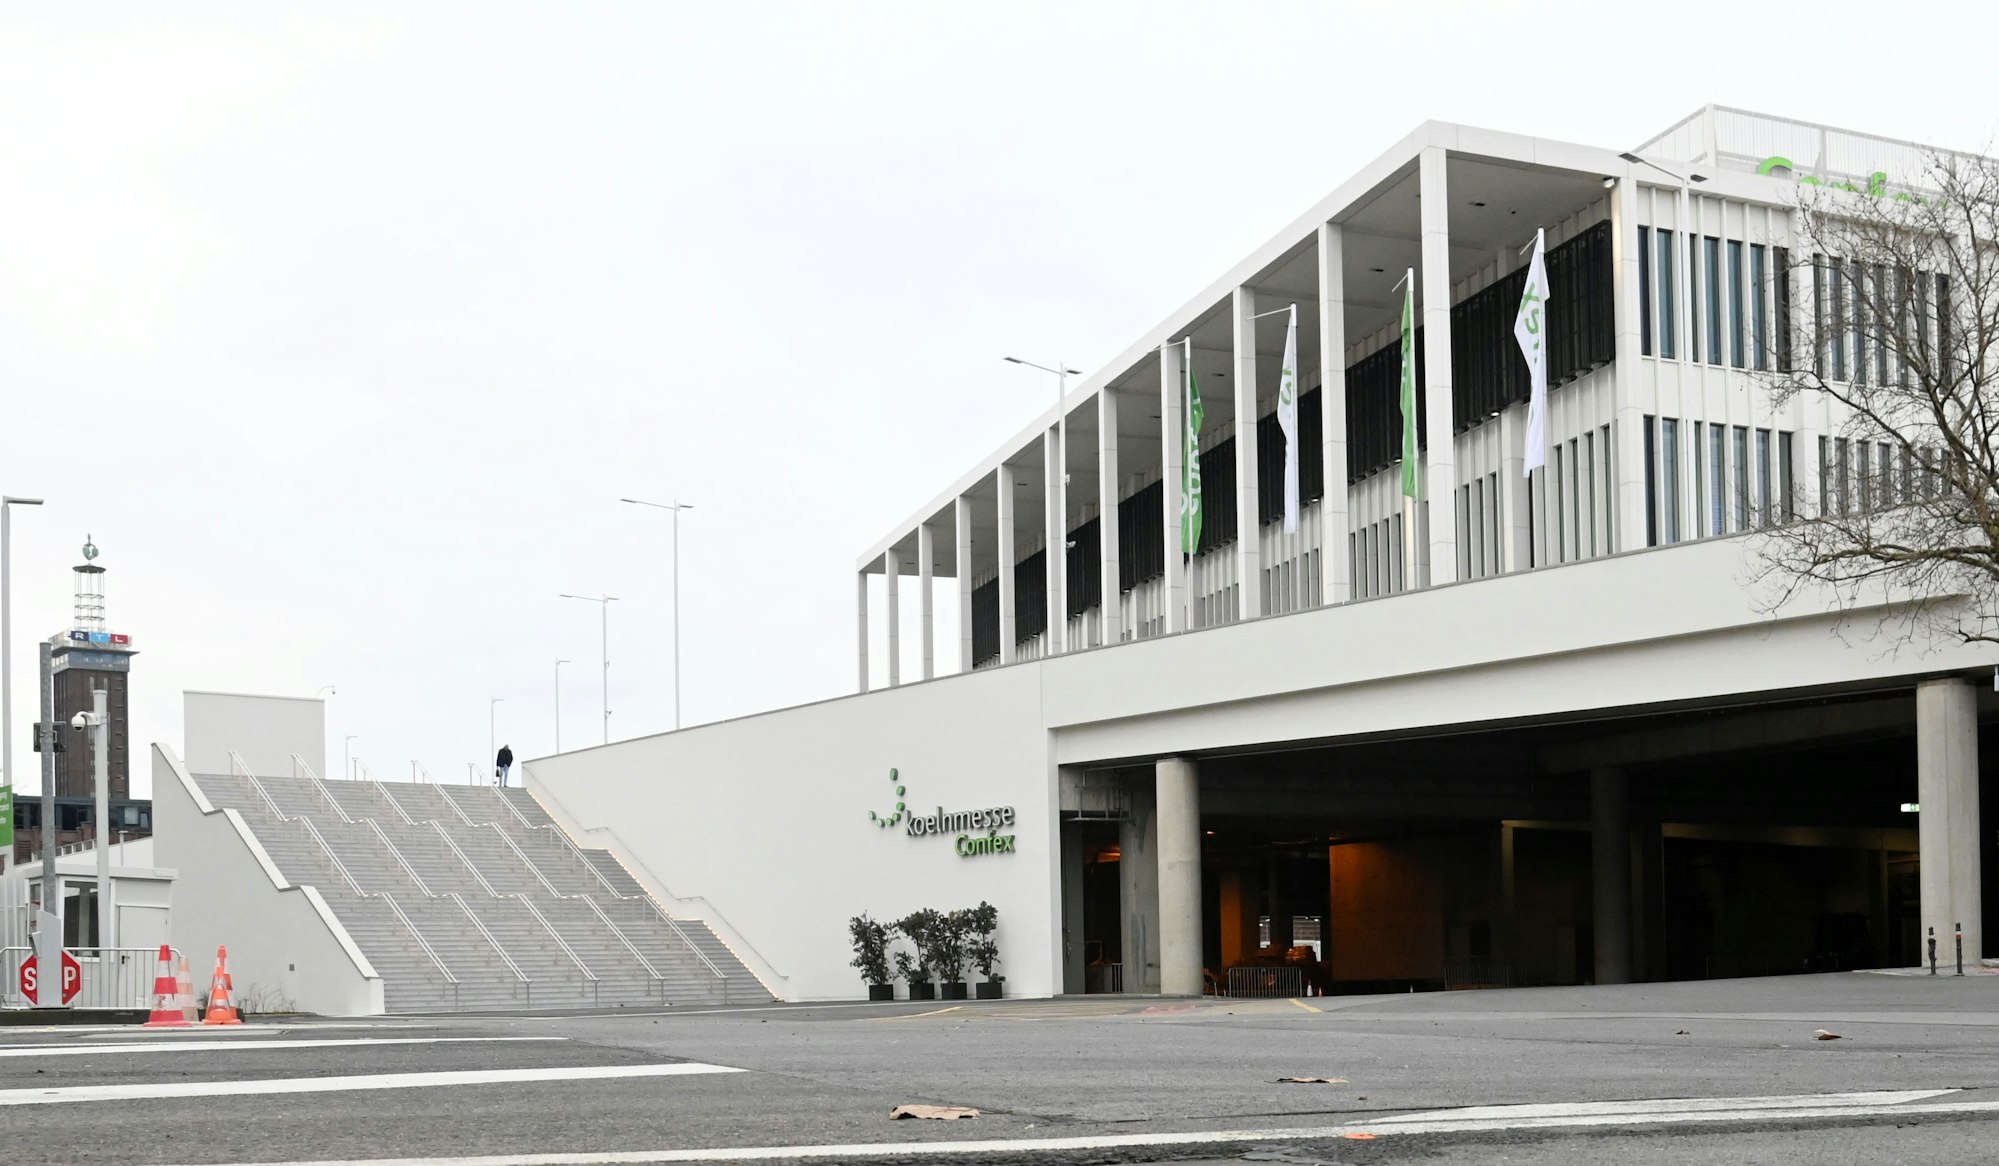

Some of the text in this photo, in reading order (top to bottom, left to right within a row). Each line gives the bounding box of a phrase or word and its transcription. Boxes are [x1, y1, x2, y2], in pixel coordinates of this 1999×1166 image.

[73, 631, 125, 643] RTL
[905, 805, 1015, 837] koelnmesse
[954, 829, 1016, 858] Confex
[24, 966, 77, 991] SP
